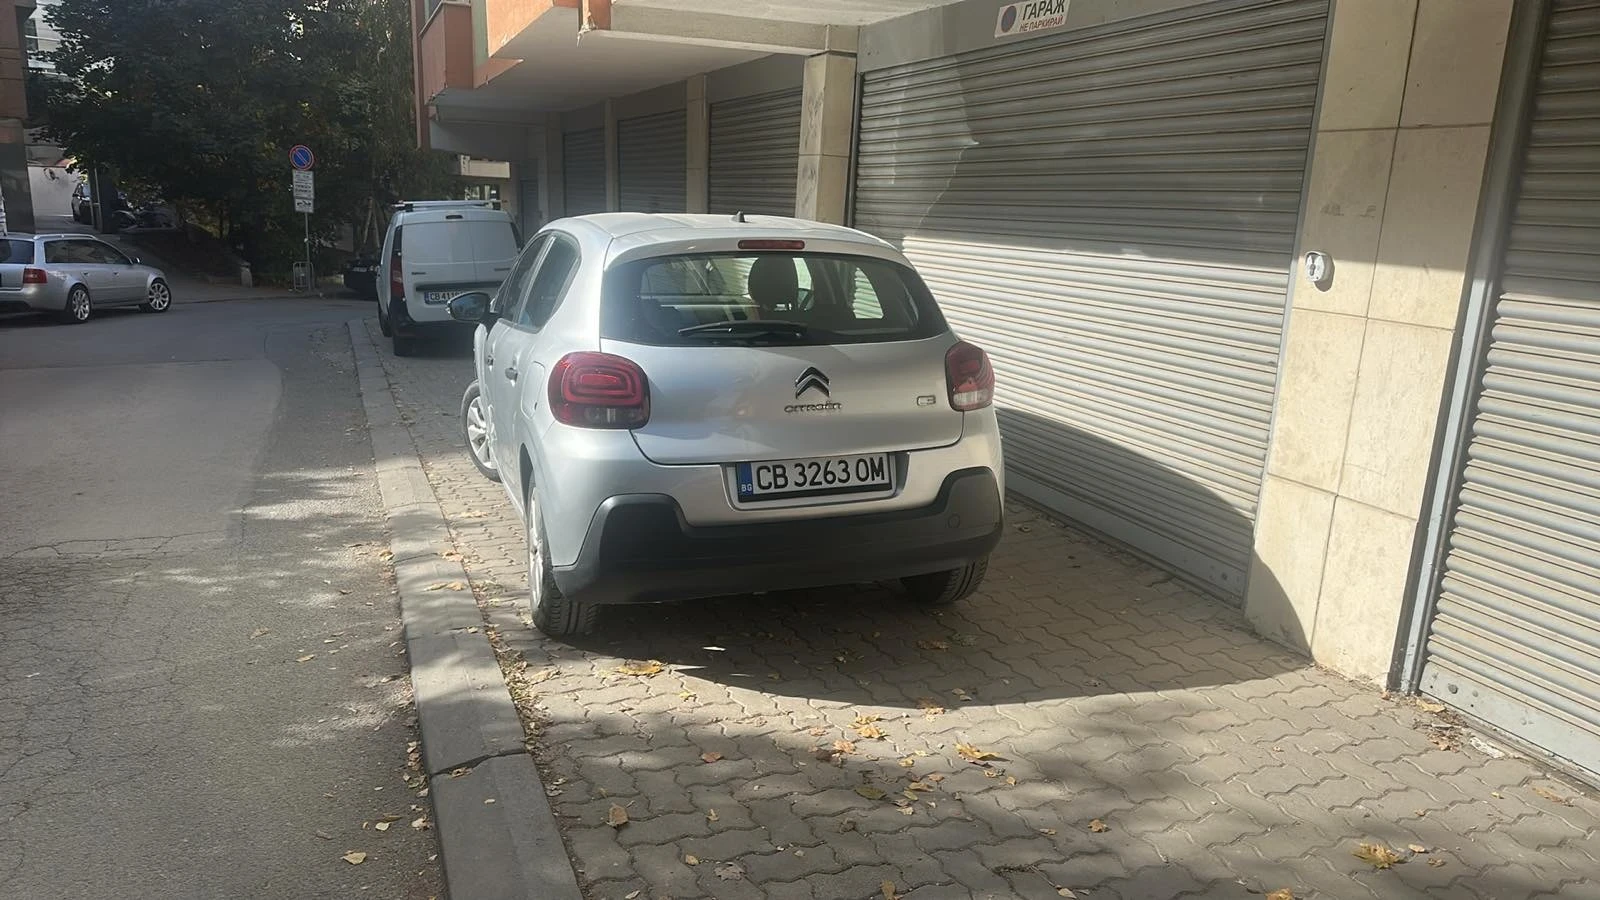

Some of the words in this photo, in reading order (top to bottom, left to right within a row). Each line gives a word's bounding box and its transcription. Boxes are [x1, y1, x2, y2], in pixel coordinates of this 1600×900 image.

[1022, 0, 1065, 20] ГАРАЖ
[1019, 22, 1029, 32] НЕ
[1029, 14, 1064, 30] ПАРКИРАЙ
[756, 464, 789, 490] CB
[793, 459, 851, 488] 3263
[855, 456, 885, 482] OM
[741, 483, 753, 492] BG
